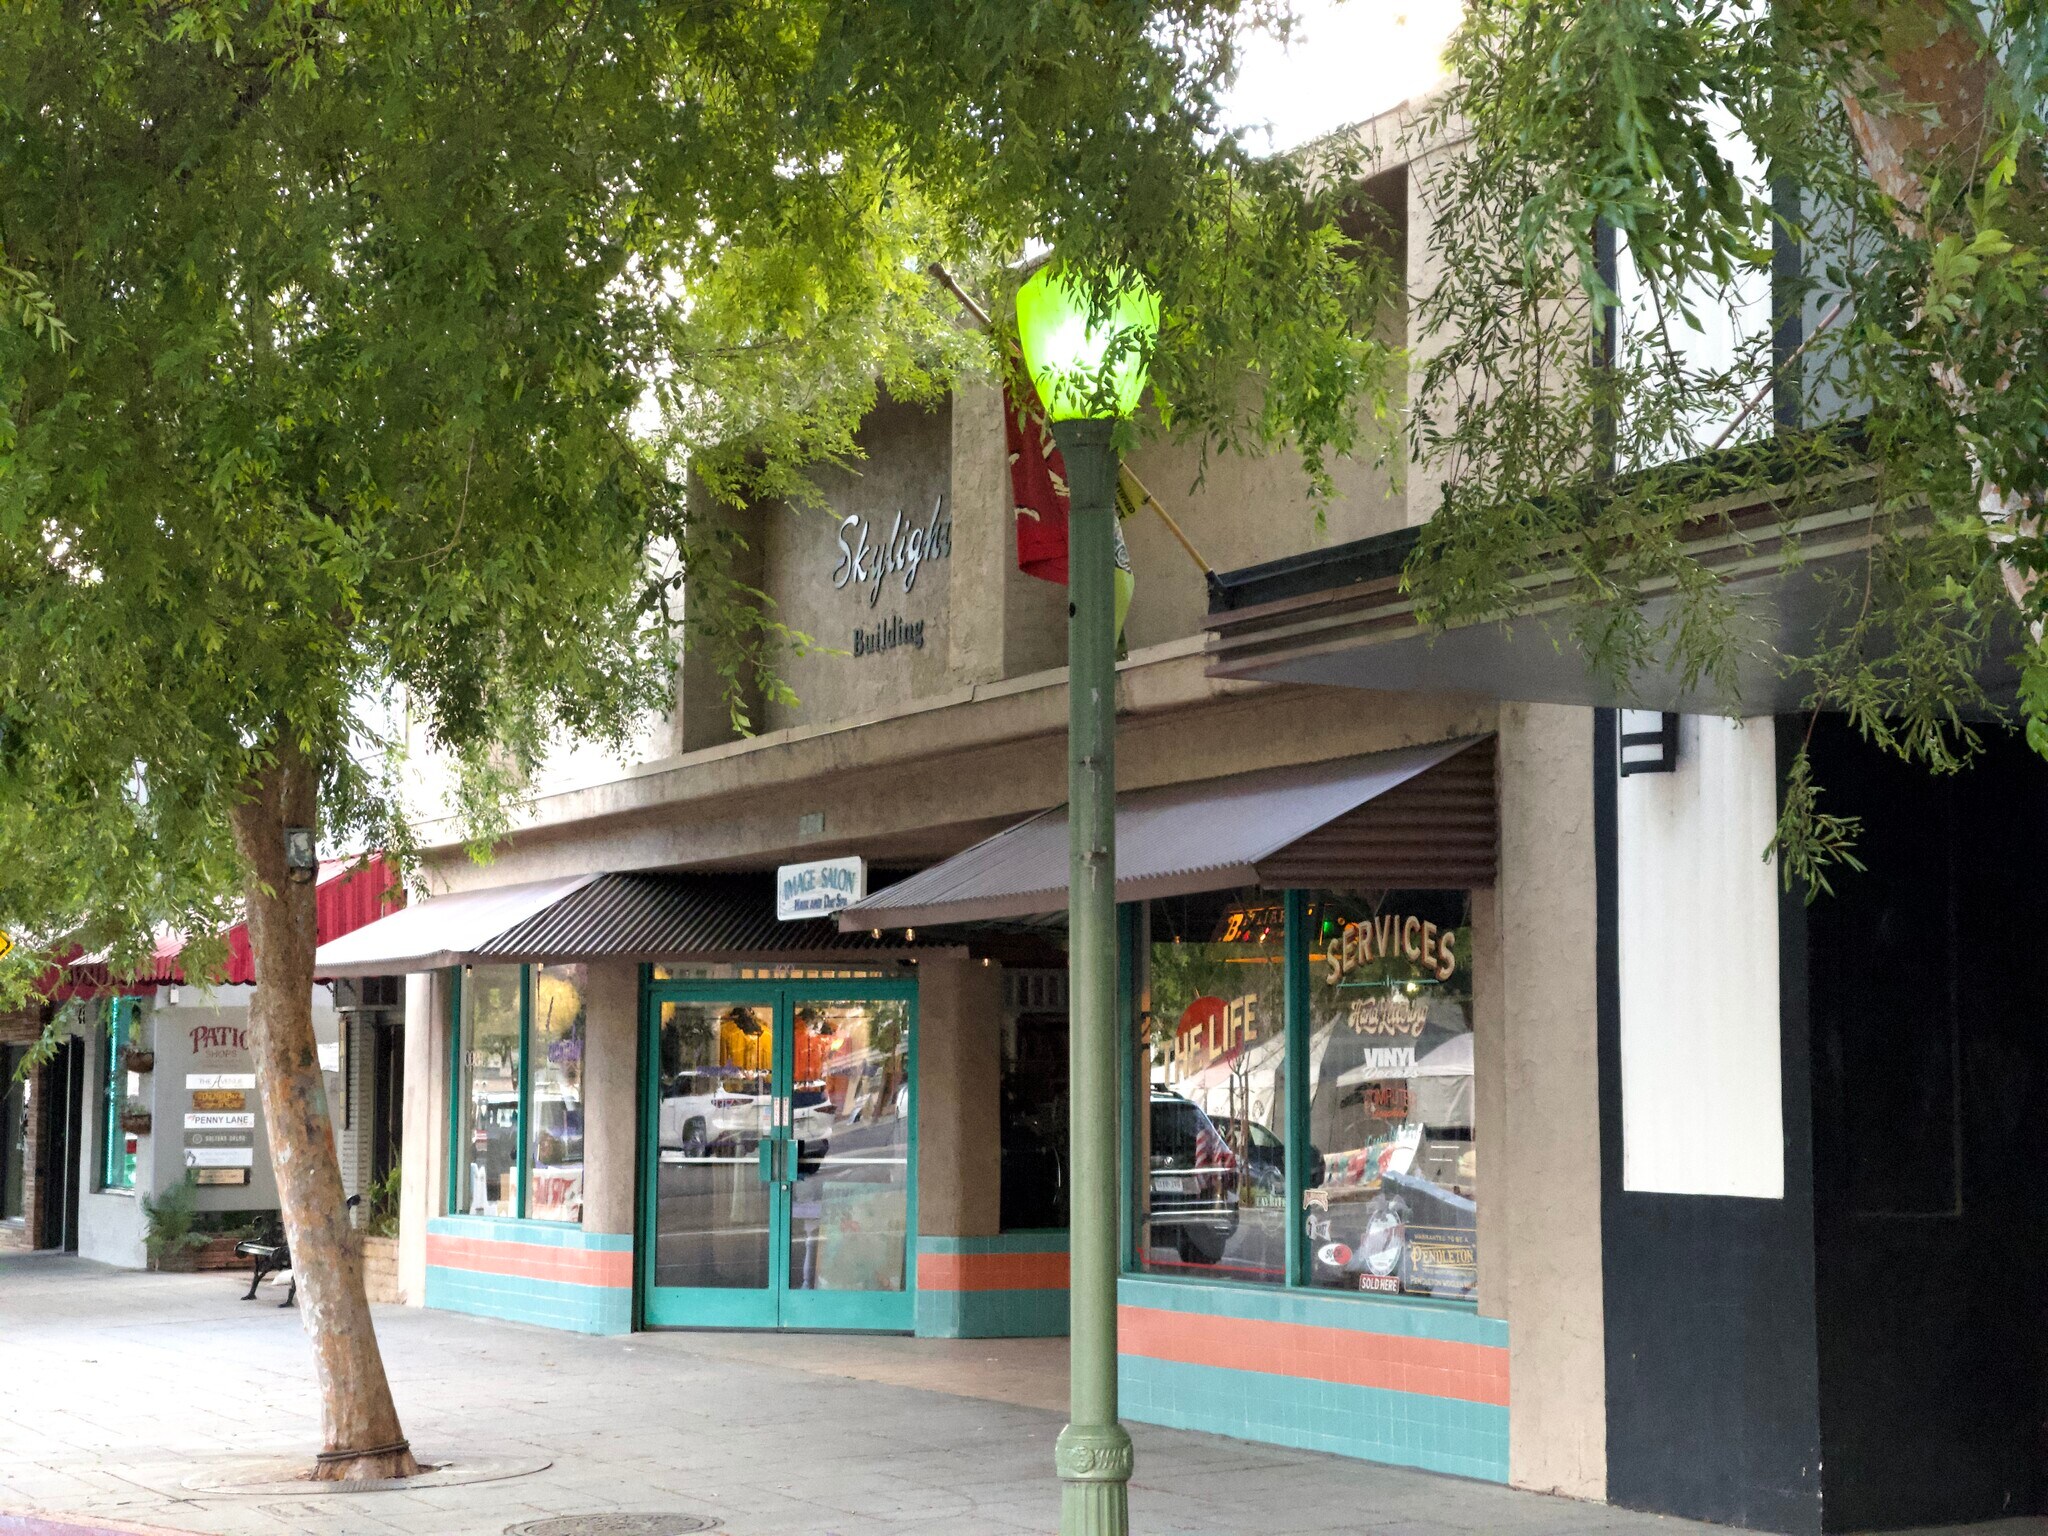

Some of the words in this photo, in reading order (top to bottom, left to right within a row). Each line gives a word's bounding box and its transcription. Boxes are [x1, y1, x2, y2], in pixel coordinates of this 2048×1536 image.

[853, 615, 924, 657] Building
[783, 869, 816, 900] IMAGE
[821, 866, 856, 894] SALON
[1326, 914, 1456, 985] SERVICES
[205, 1049, 238, 1058] SHOPS
[1159, 1023, 1203, 1089] THE
[1208, 993, 1258, 1061] LIFE
[1363, 1047, 1419, 1067] VINYL
[194, 1115, 224, 1124] PENNY
[226, 1115, 249, 1124] LANE
[1410, 1245, 1474, 1272] PENDLETON
[1361, 1277, 1380, 1290] SOLD
[1380, 1278, 1397, 1292] HERE
